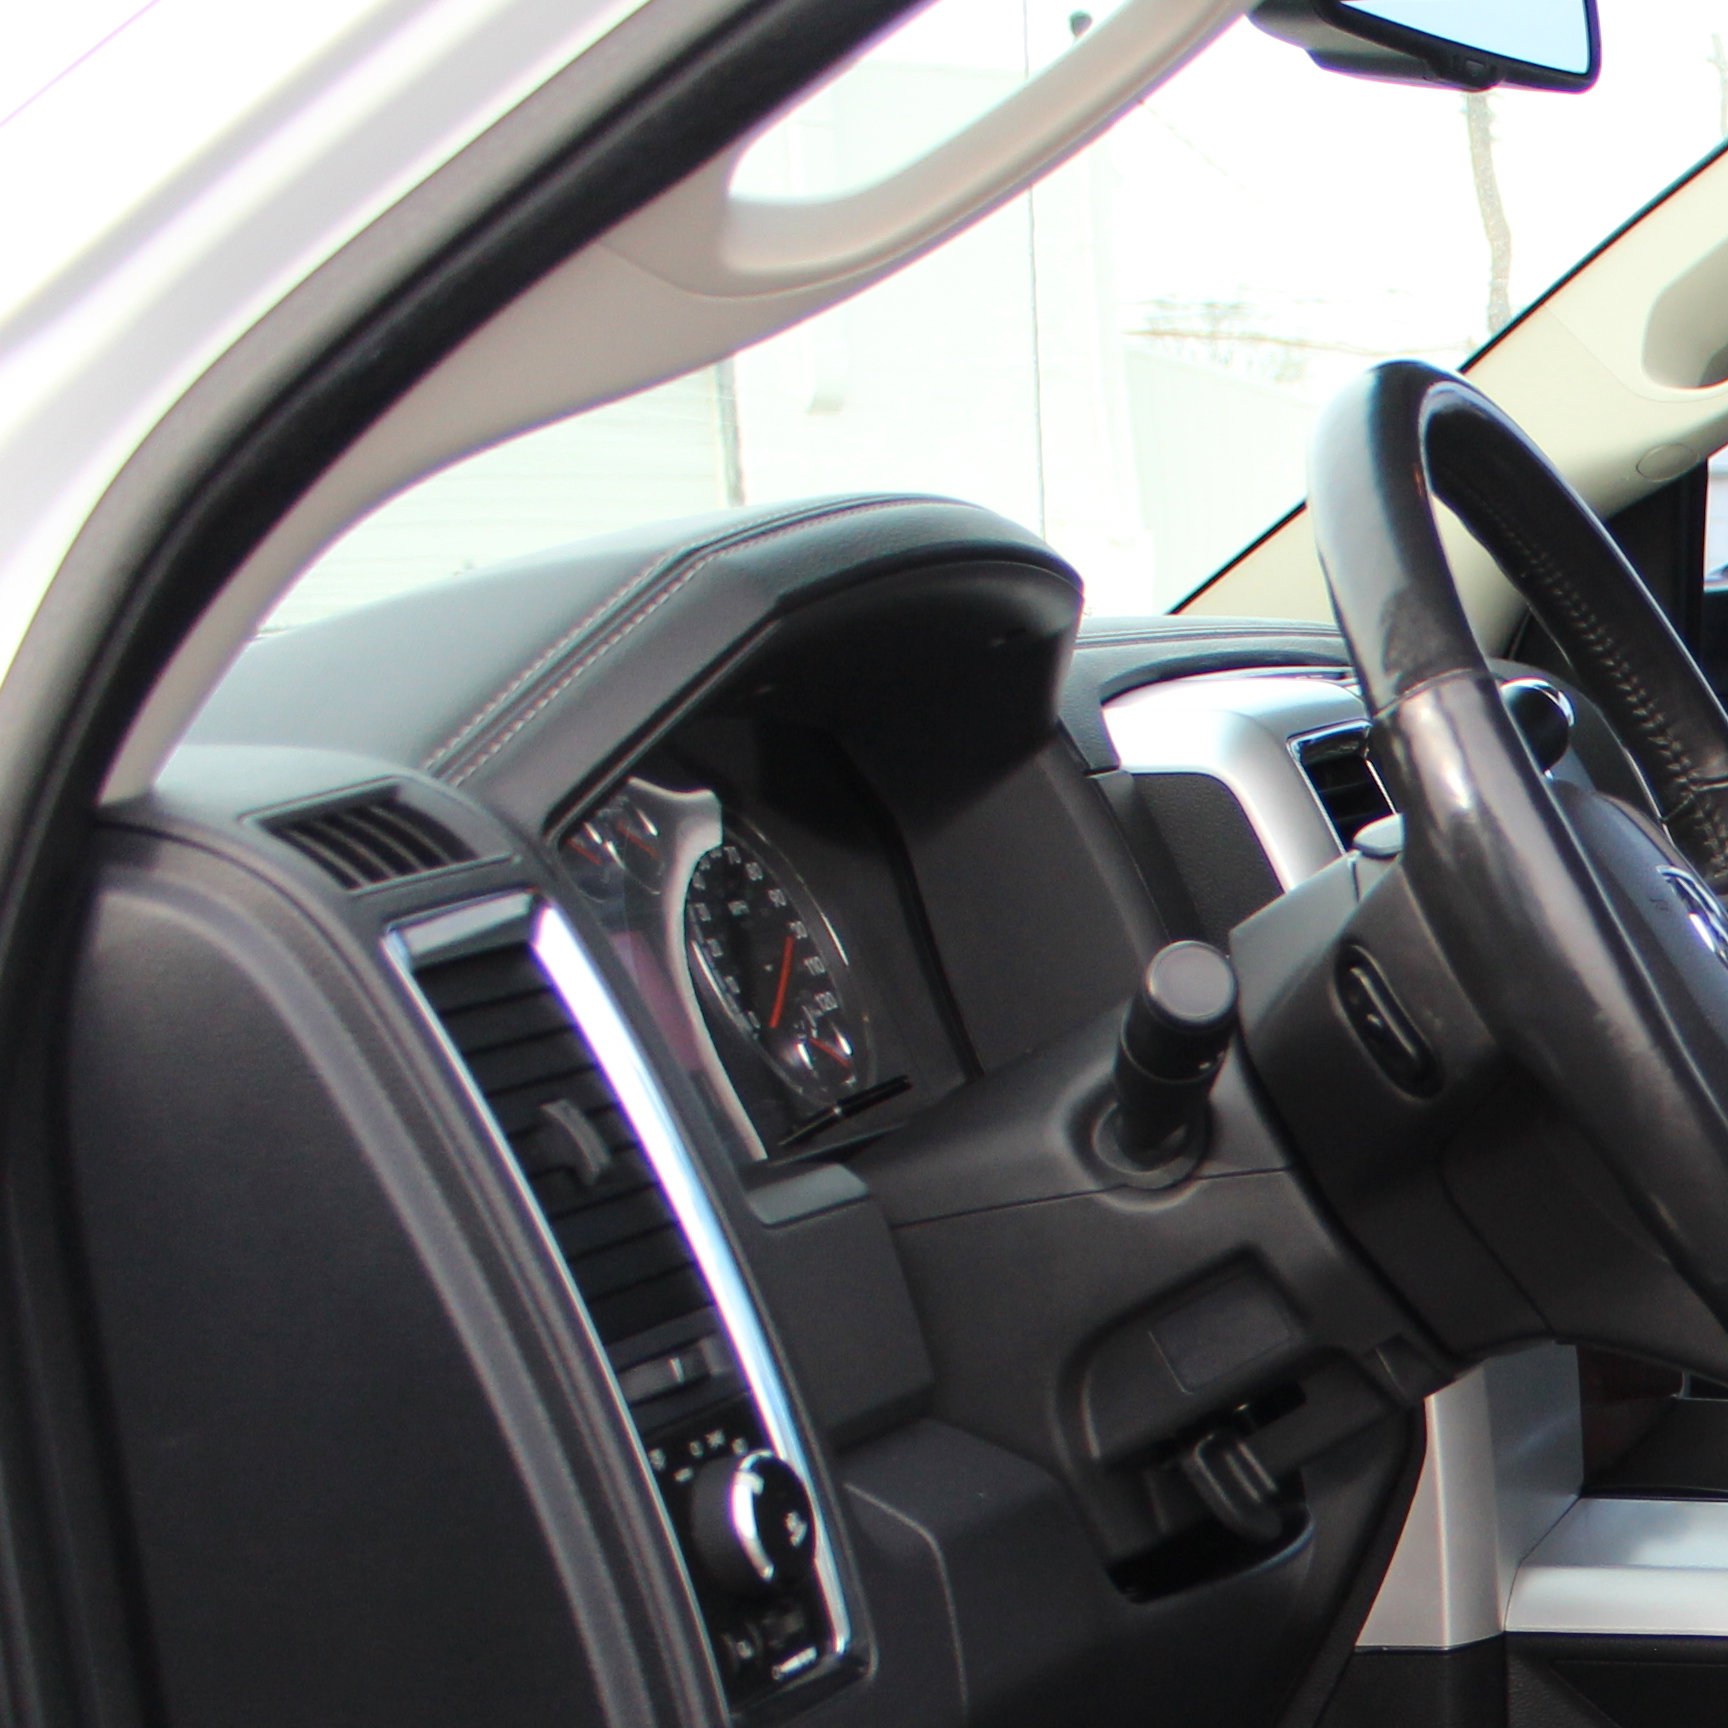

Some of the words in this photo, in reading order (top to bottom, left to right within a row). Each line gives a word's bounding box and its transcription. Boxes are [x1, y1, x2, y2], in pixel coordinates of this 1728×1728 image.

[723, 846, 741, 864] 70
[804, 956, 826, 975] 110
[815, 991, 839, 1011] 120
